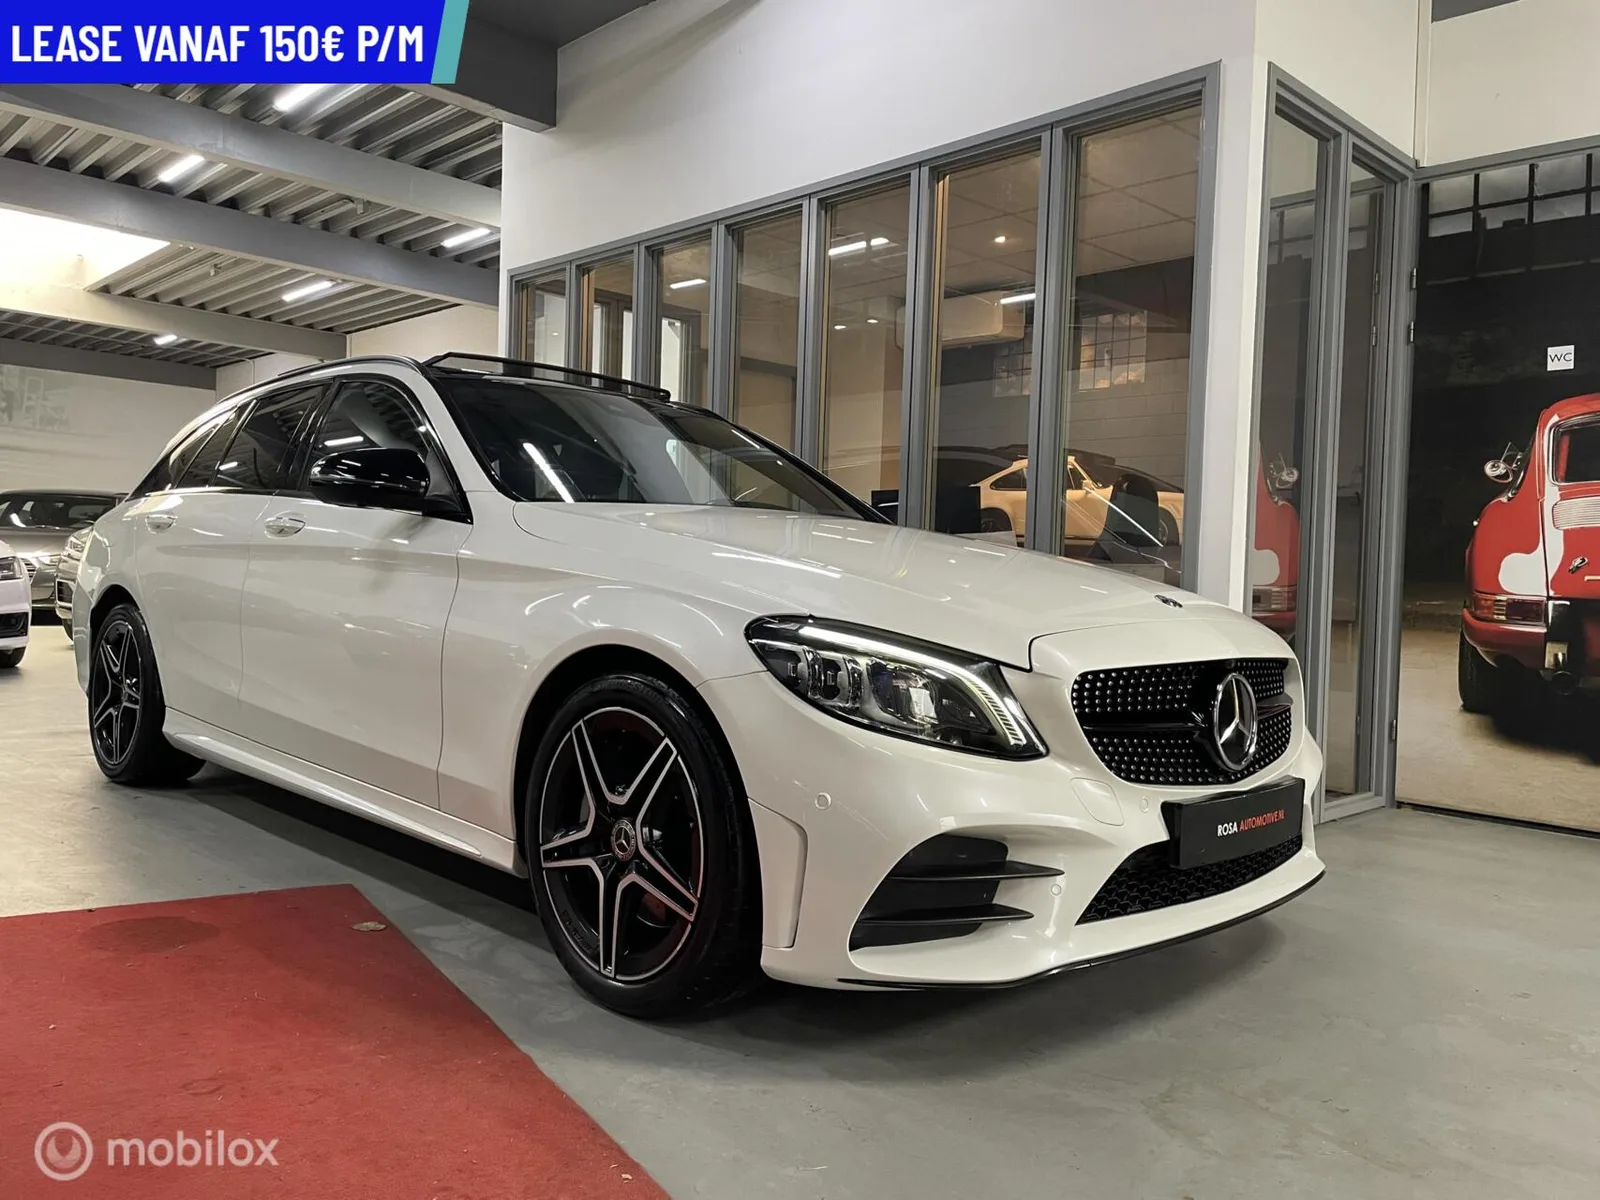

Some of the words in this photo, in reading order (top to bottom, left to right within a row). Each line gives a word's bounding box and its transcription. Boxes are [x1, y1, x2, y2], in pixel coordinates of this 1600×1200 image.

[1549, 352, 1573, 363] WC
[1217, 821, 1238, 837] ROSA
[1239, 809, 1285, 832] AUTOMOTIVE.NL
